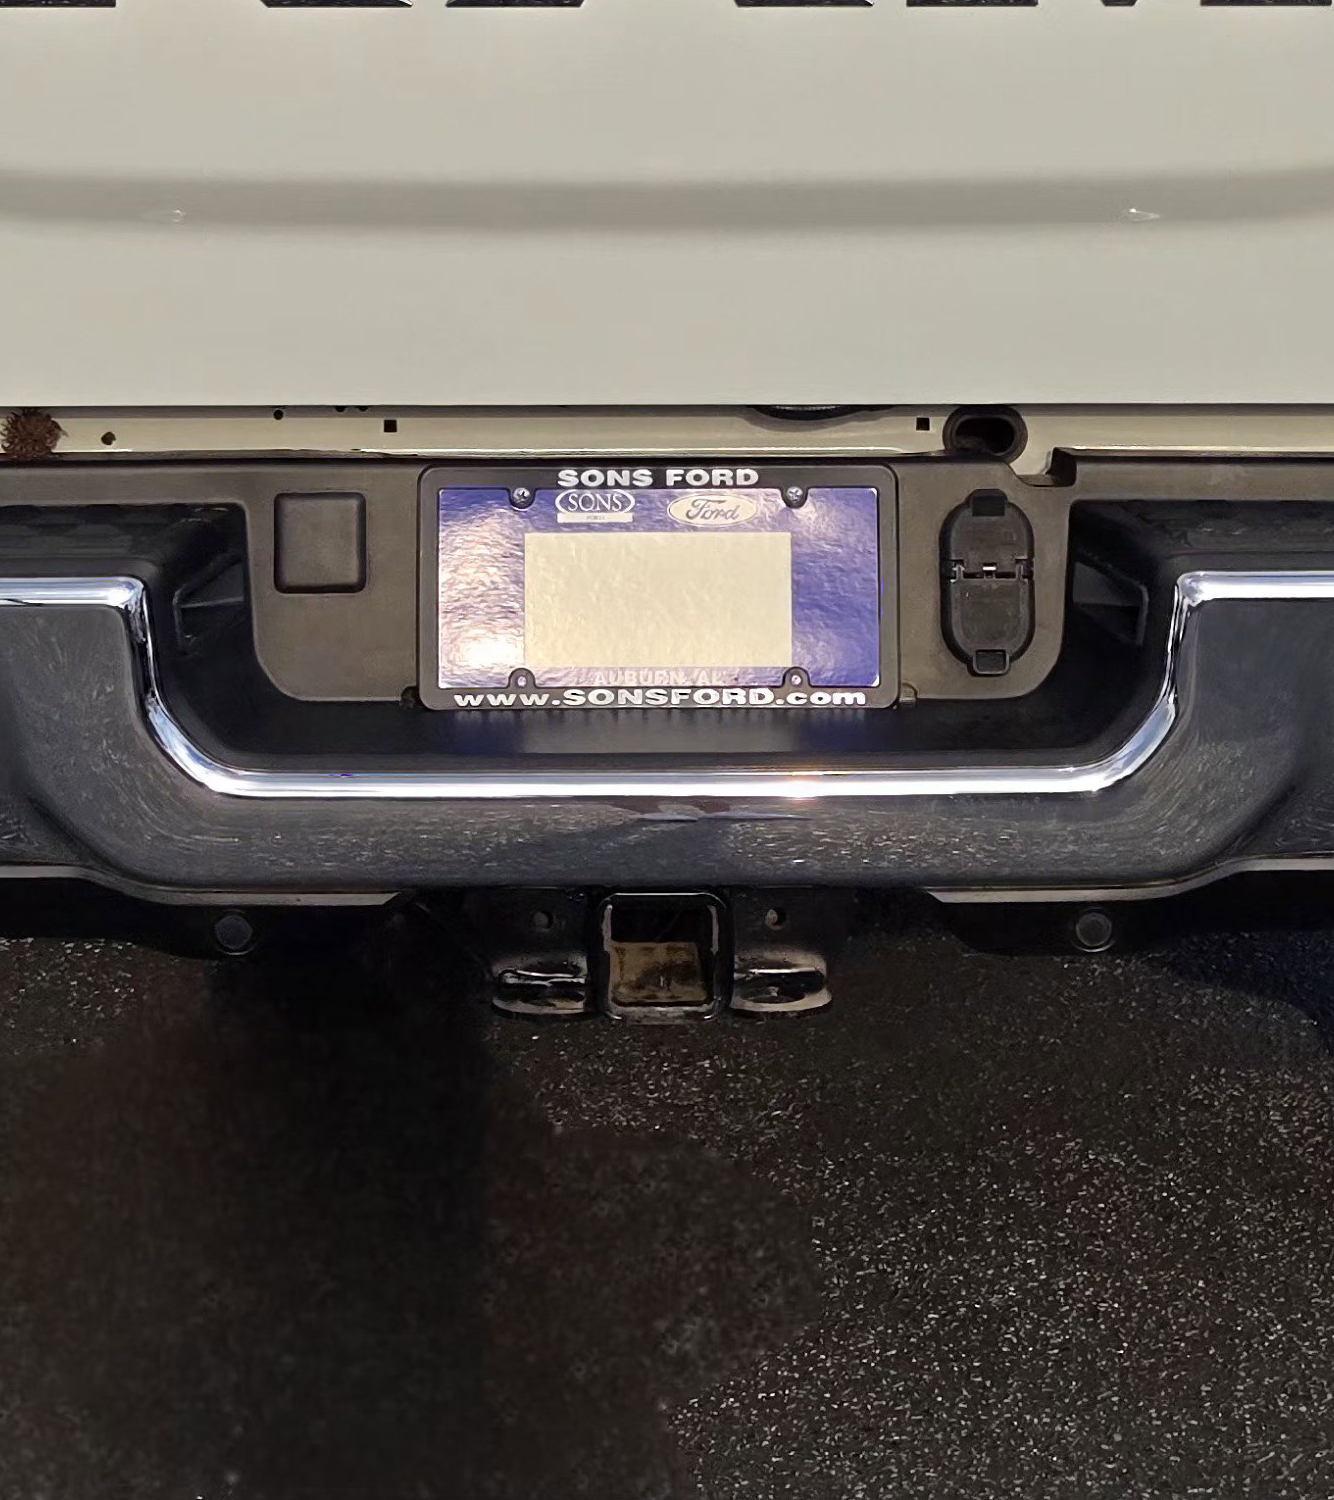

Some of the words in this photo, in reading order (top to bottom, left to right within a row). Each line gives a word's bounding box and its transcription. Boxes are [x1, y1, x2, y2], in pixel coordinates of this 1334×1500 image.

[557, 468, 653, 487] SONS
[665, 468, 759, 487] FORD
[567, 492, 623, 512] SONS
[685, 498, 741, 521] Ford
[453, 688, 867, 708] www.SONSFORD.com
